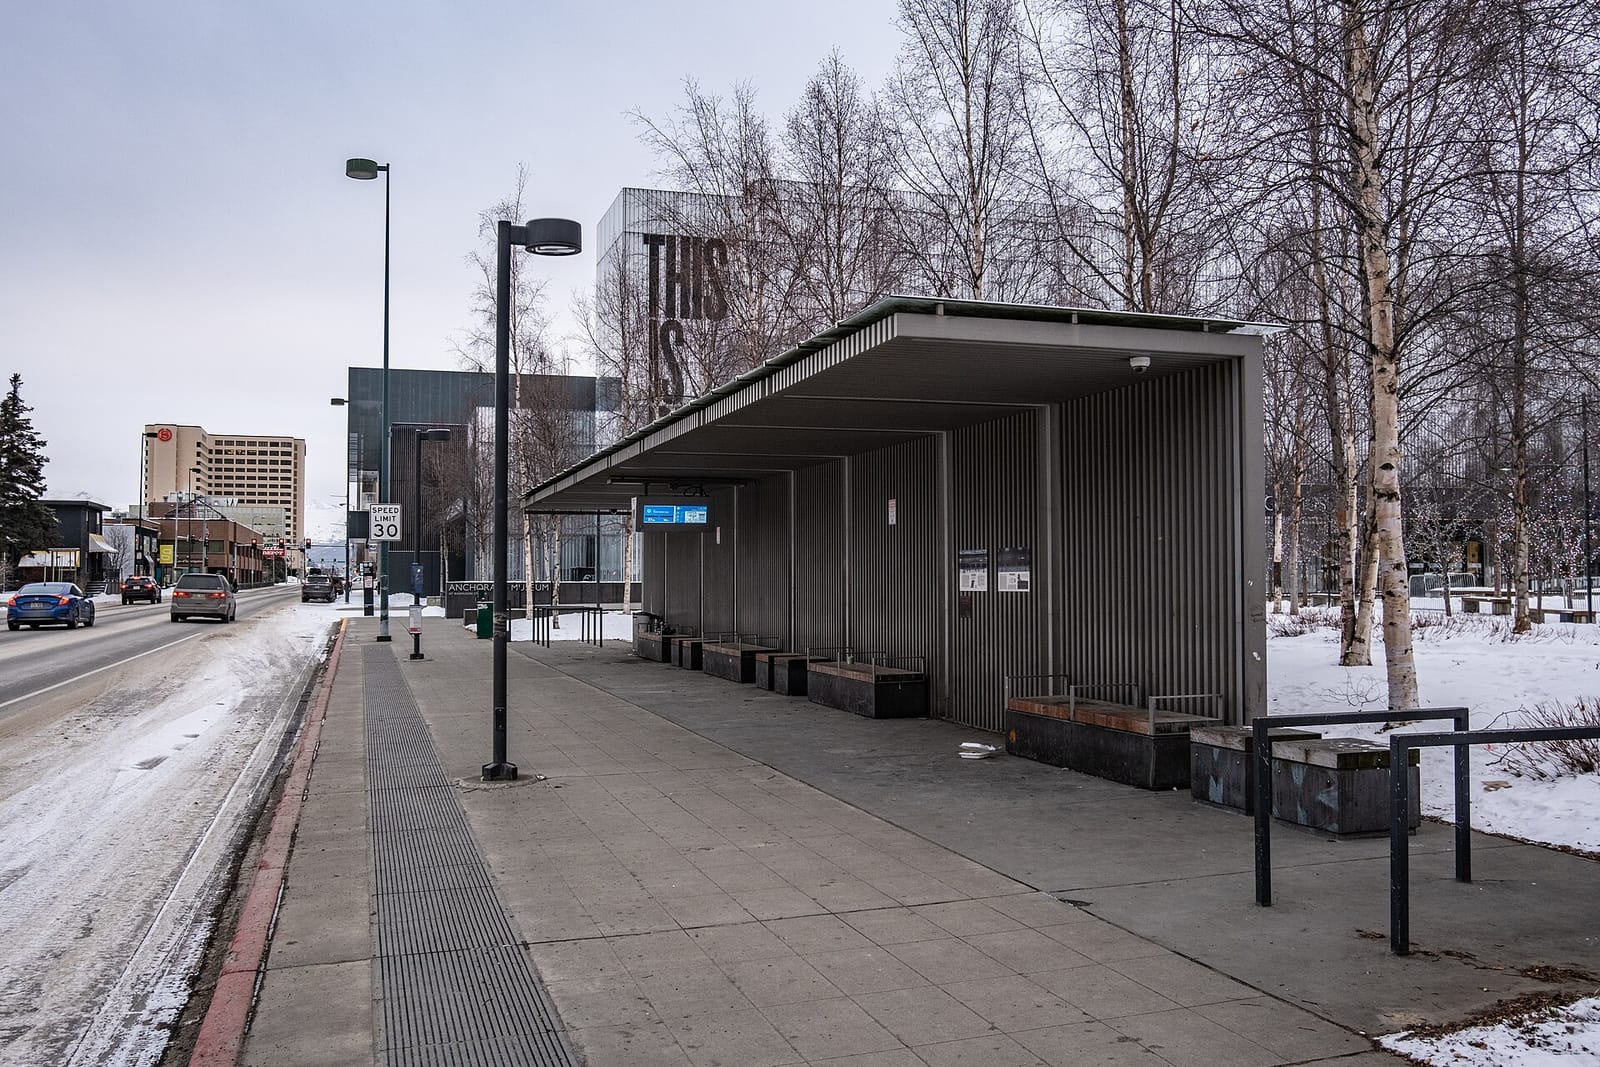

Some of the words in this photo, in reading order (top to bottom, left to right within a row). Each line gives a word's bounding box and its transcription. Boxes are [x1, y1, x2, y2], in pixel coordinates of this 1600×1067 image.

[643, 234, 728, 321] THIS
[649, 319, 684, 404] IS
[374, 523, 398, 537] 30
[448, 583, 495, 592] ANCHORA
[510, 583, 549, 592] MUEUM
